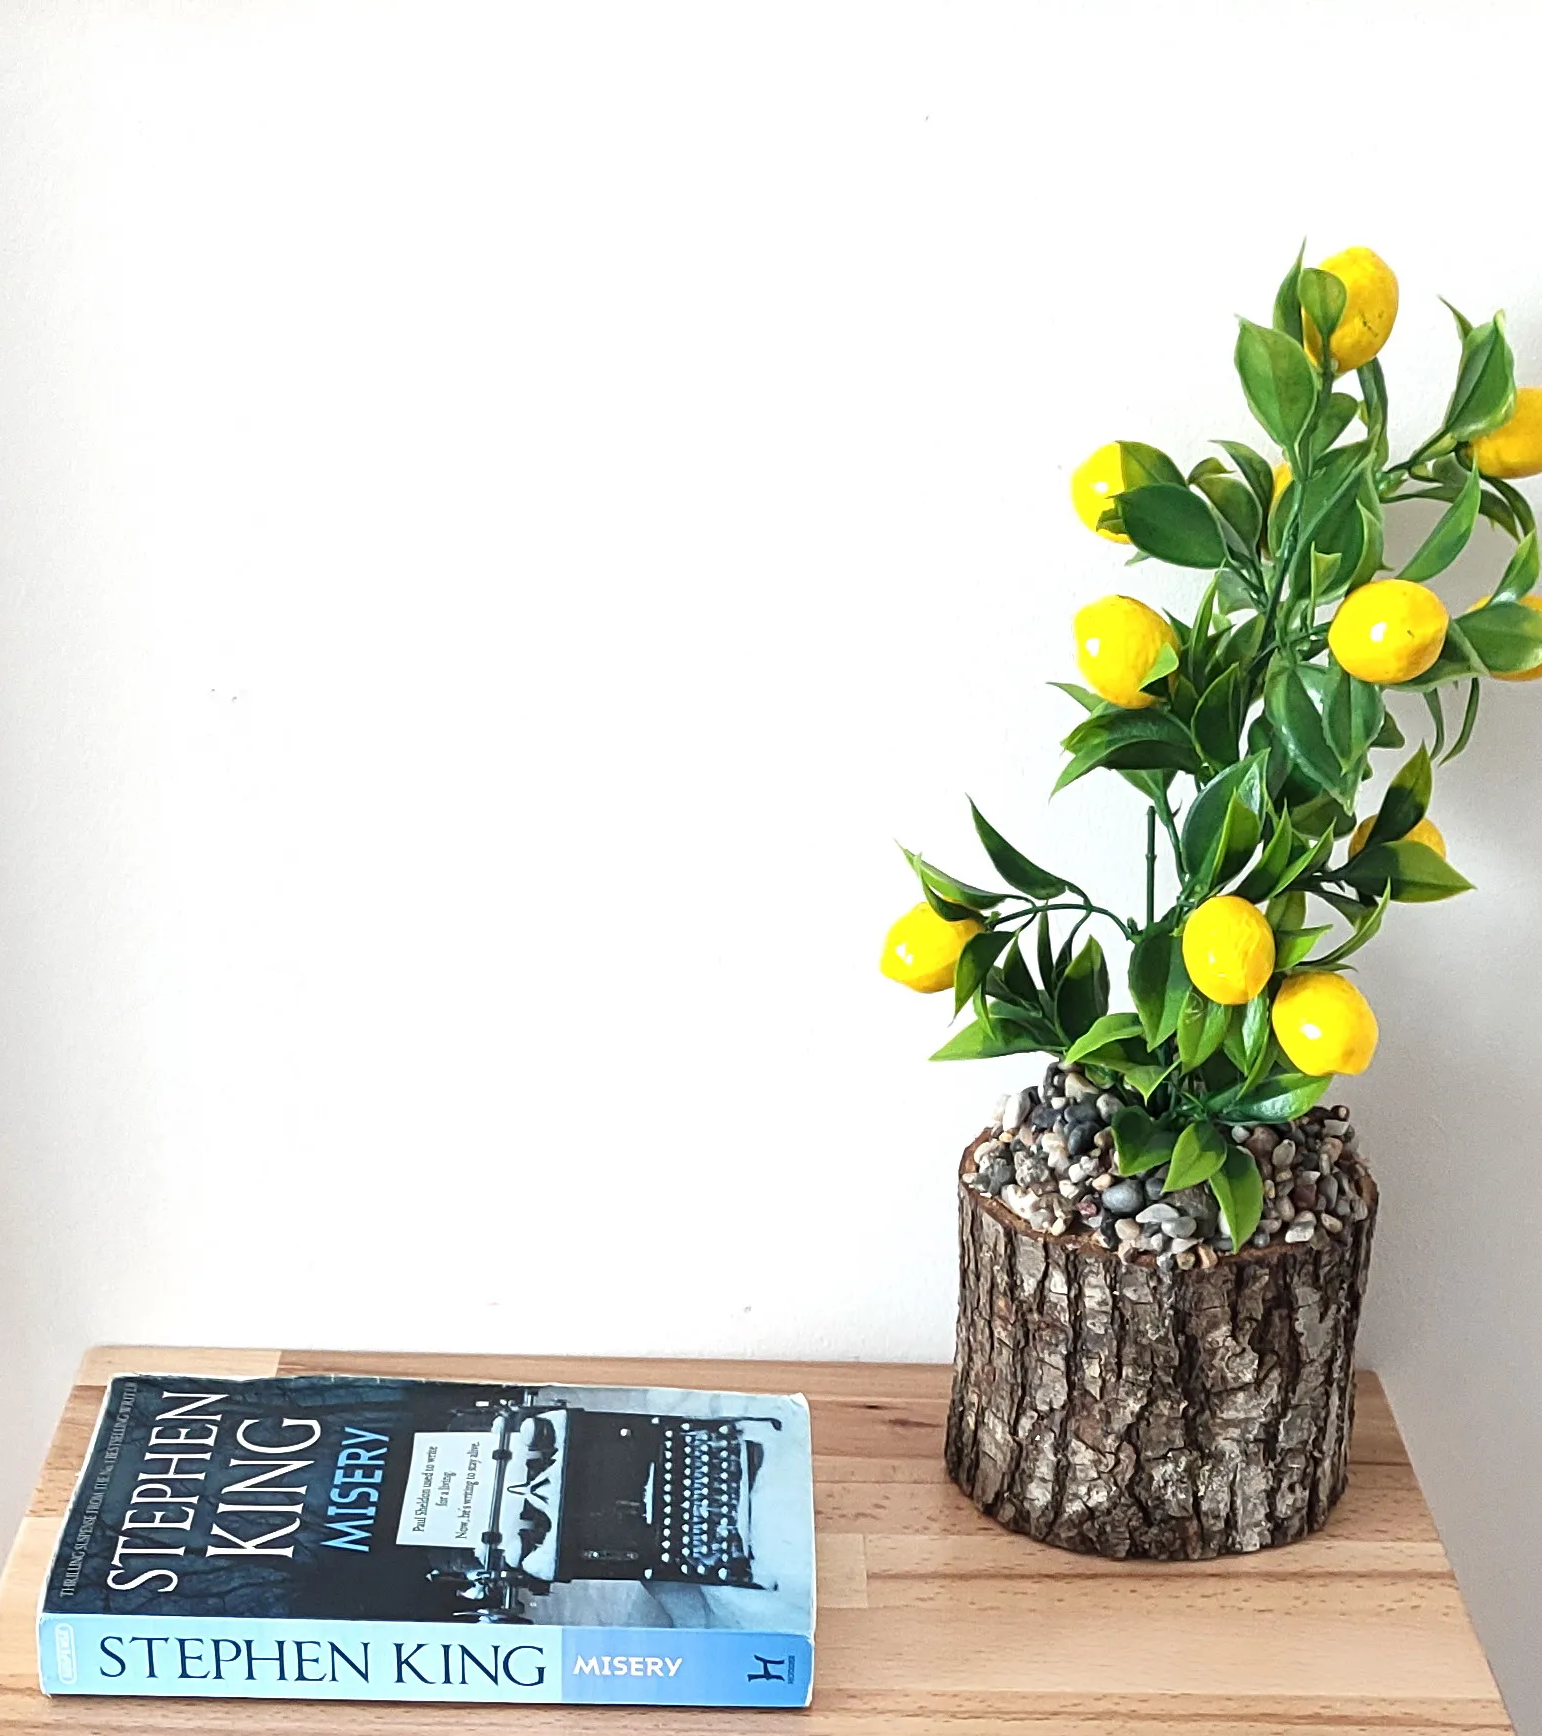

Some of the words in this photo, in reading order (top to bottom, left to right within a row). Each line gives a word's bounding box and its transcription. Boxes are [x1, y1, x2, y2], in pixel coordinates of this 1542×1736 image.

[104, 1414, 130, 1460] BESTSELLING
[427, 1445, 438, 1464] write
[468, 1458, 482, 1472] stay
[421, 1472, 434, 1488] used
[426, 1464, 435, 1472] to
[465, 1472, 476, 1480] to
[106, 1390, 231, 1593] STEPHEN
[205, 1417, 322, 1559] KING
[320, 1426, 390, 1553] MISERY
[463, 1480, 480, 1505] writing
[85, 1491, 104, 1515] FROM
[415, 1488, 431, 1516] Sheldon
[435, 1496, 448, 1507] for
[75, 1515, 97, 1551] SUSPENSE
[412, 1516, 427, 1533] Paul
[59, 1549, 86, 1598] THRILLING
[99, 1636, 370, 1684] STEPHEN
[393, 1642, 546, 1687] KING
[573, 1654, 683, 1678] MISERY
